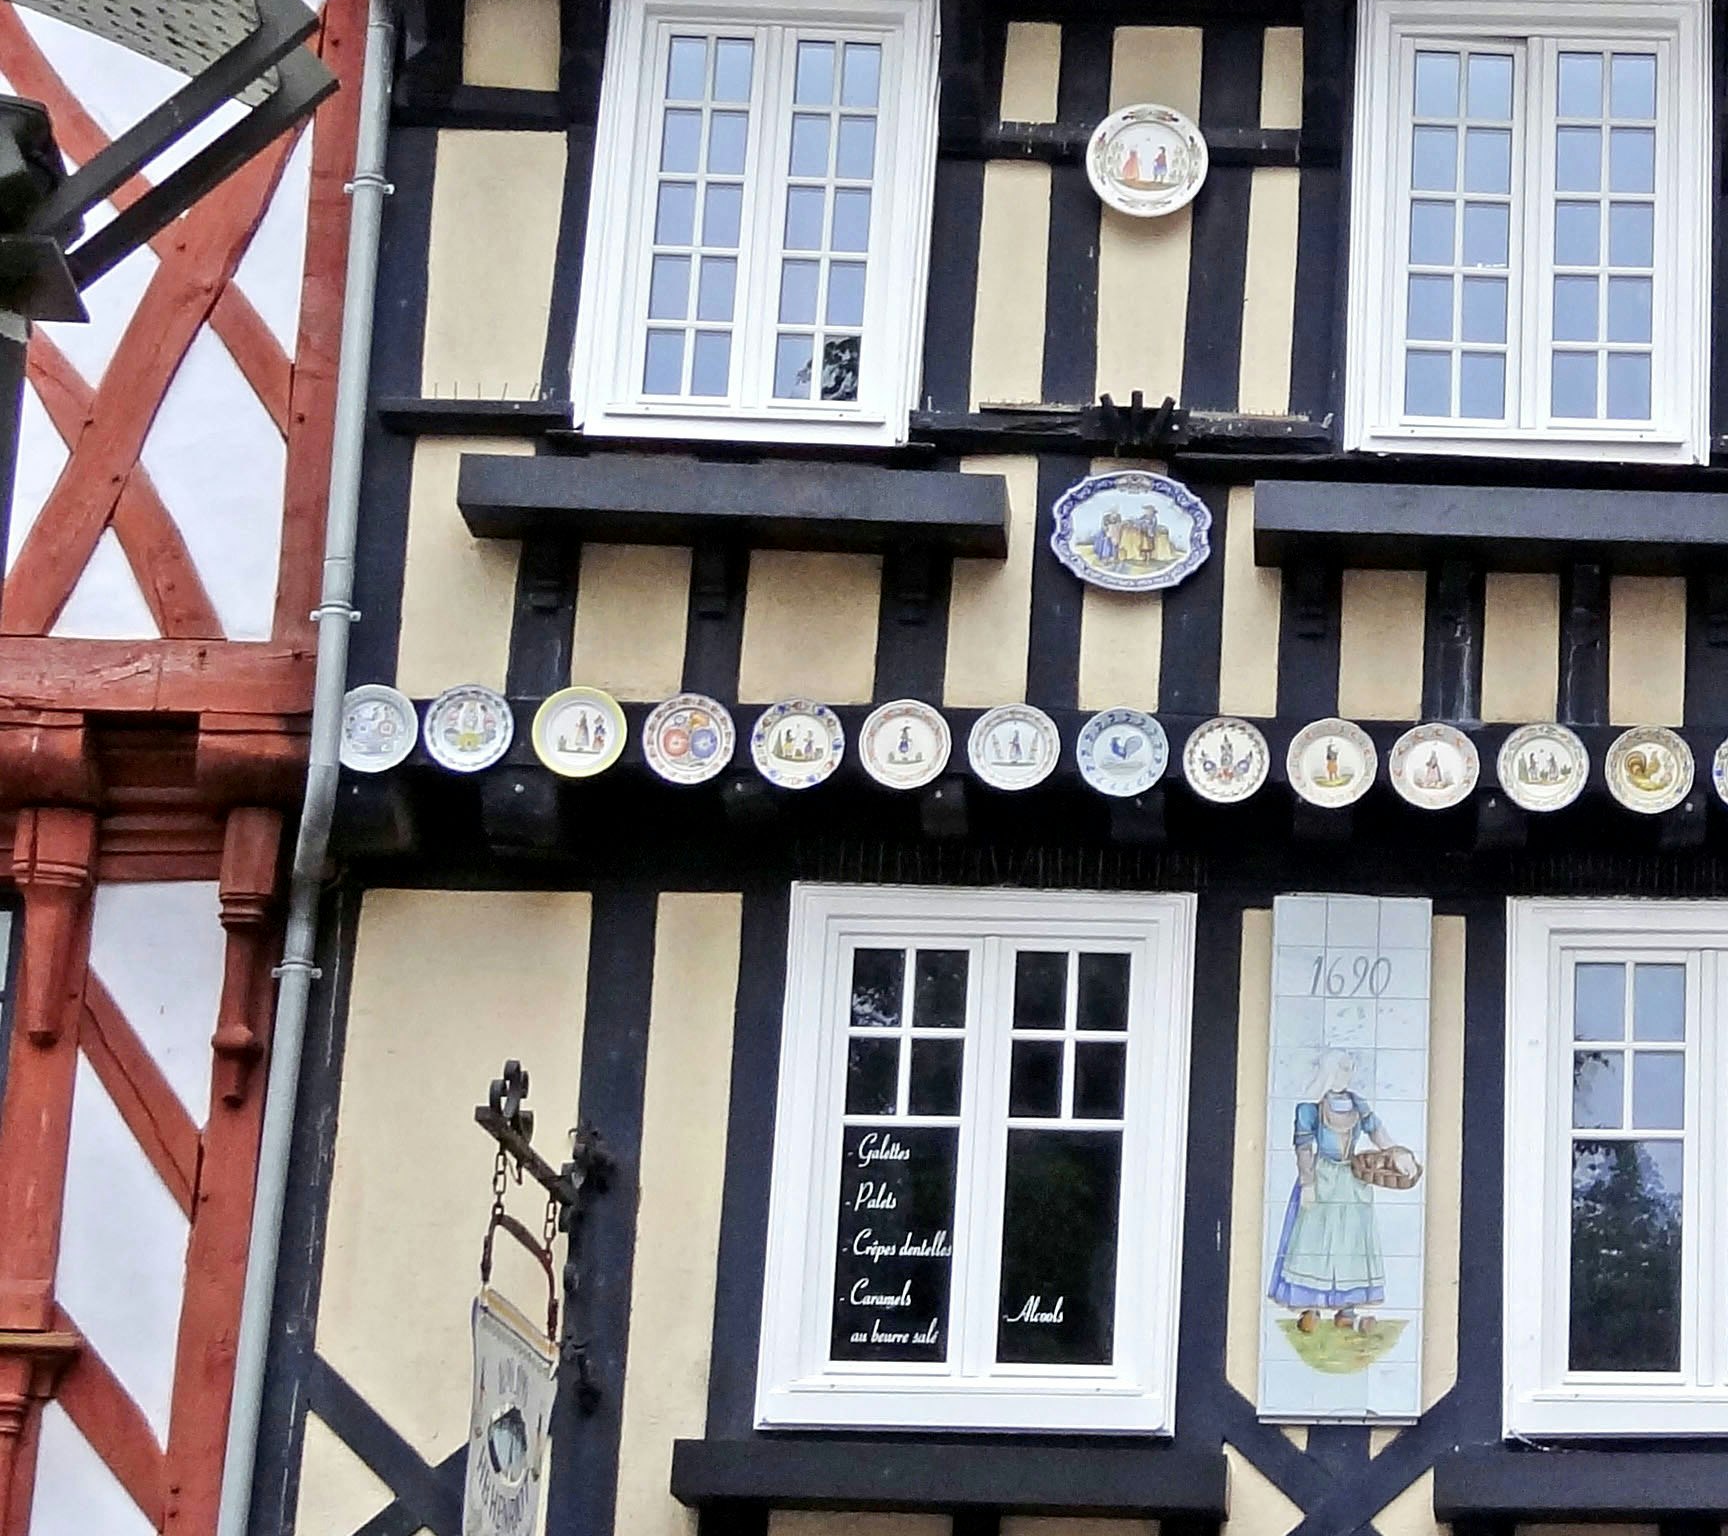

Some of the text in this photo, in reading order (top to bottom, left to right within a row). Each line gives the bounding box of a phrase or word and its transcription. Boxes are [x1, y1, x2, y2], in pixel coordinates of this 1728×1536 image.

[1309, 955, 1392, 997] 1690
[858, 1132, 910, 1170] Galettes
[854, 1182, 897, 1212] Palets
[853, 1228, 952, 1263] Crêpes dentelles
[850, 1278, 912, 1308] Caramels
[1007, 1295, 1063, 1323] Alcools
[850, 1318, 938, 1345] au beurre salé
